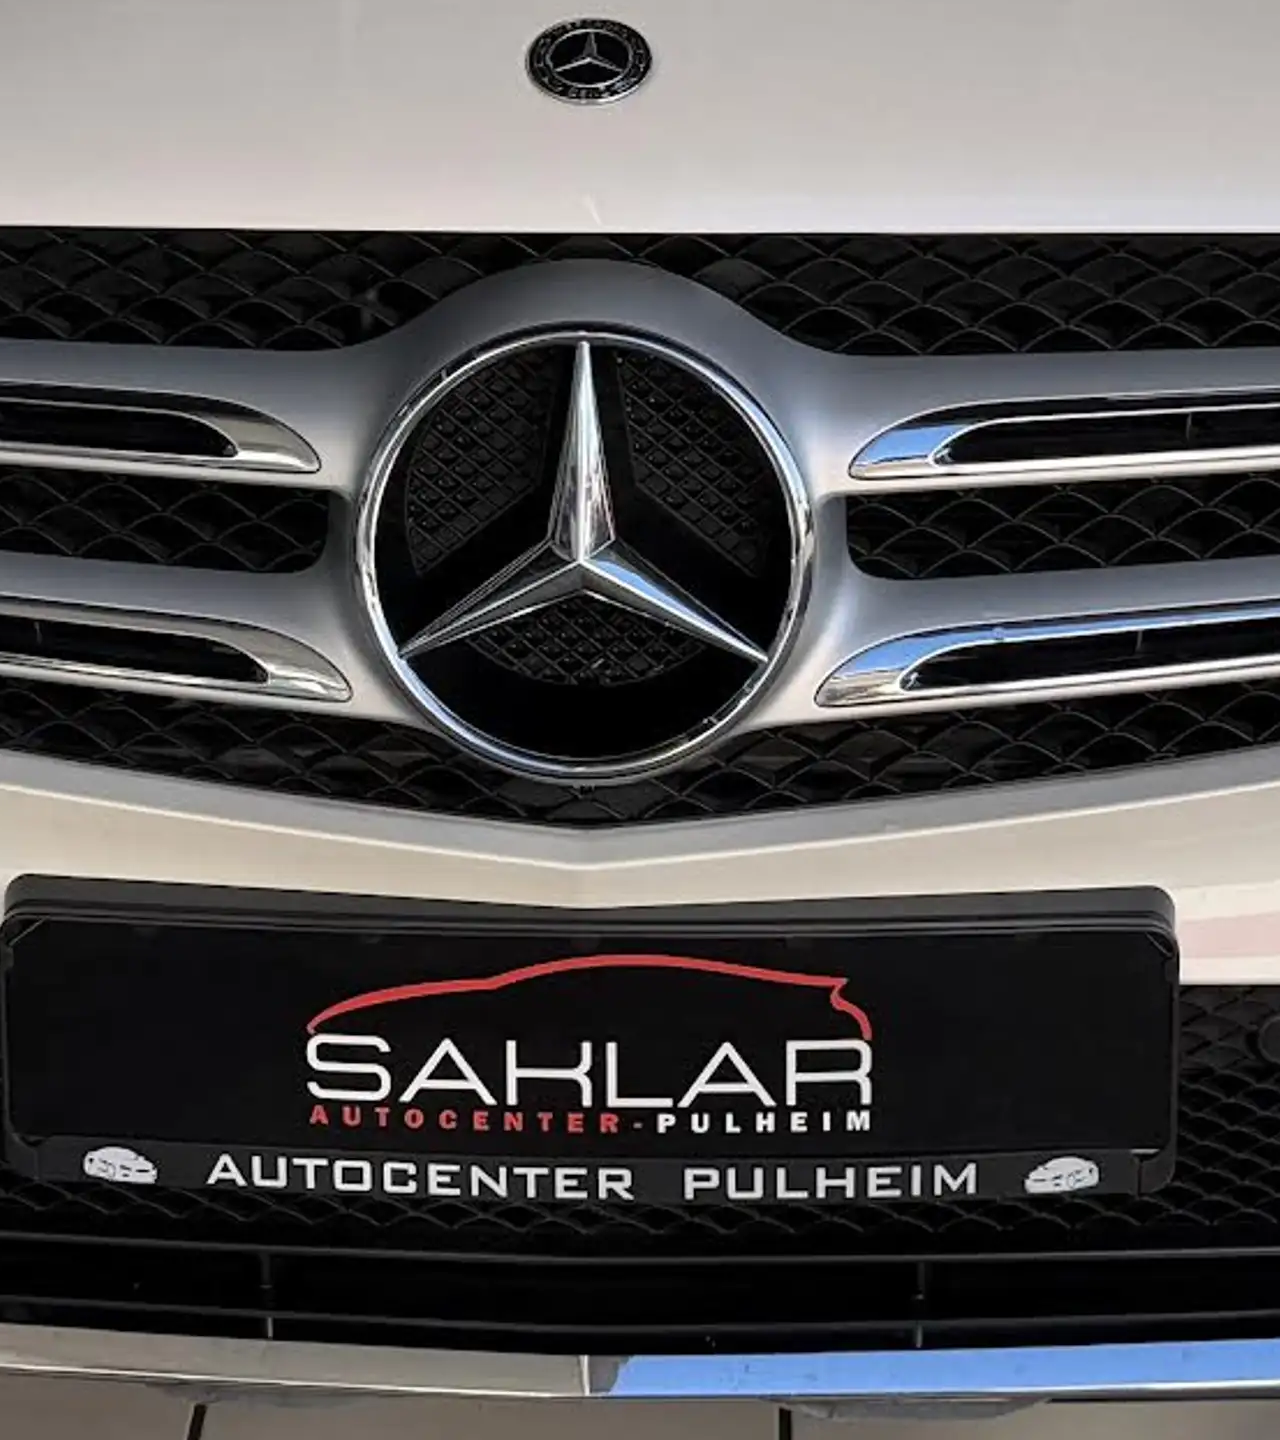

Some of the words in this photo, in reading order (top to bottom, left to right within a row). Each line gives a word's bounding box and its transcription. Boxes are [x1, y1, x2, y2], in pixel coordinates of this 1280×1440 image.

[307, 1034, 872, 1108] SAHLAR
[310, 1105, 871, 1133] AUTOCENTER-PULHEIM
[207, 1154, 634, 1200] AUTOCENTER
[684, 1162, 977, 1200] PULHEIM
